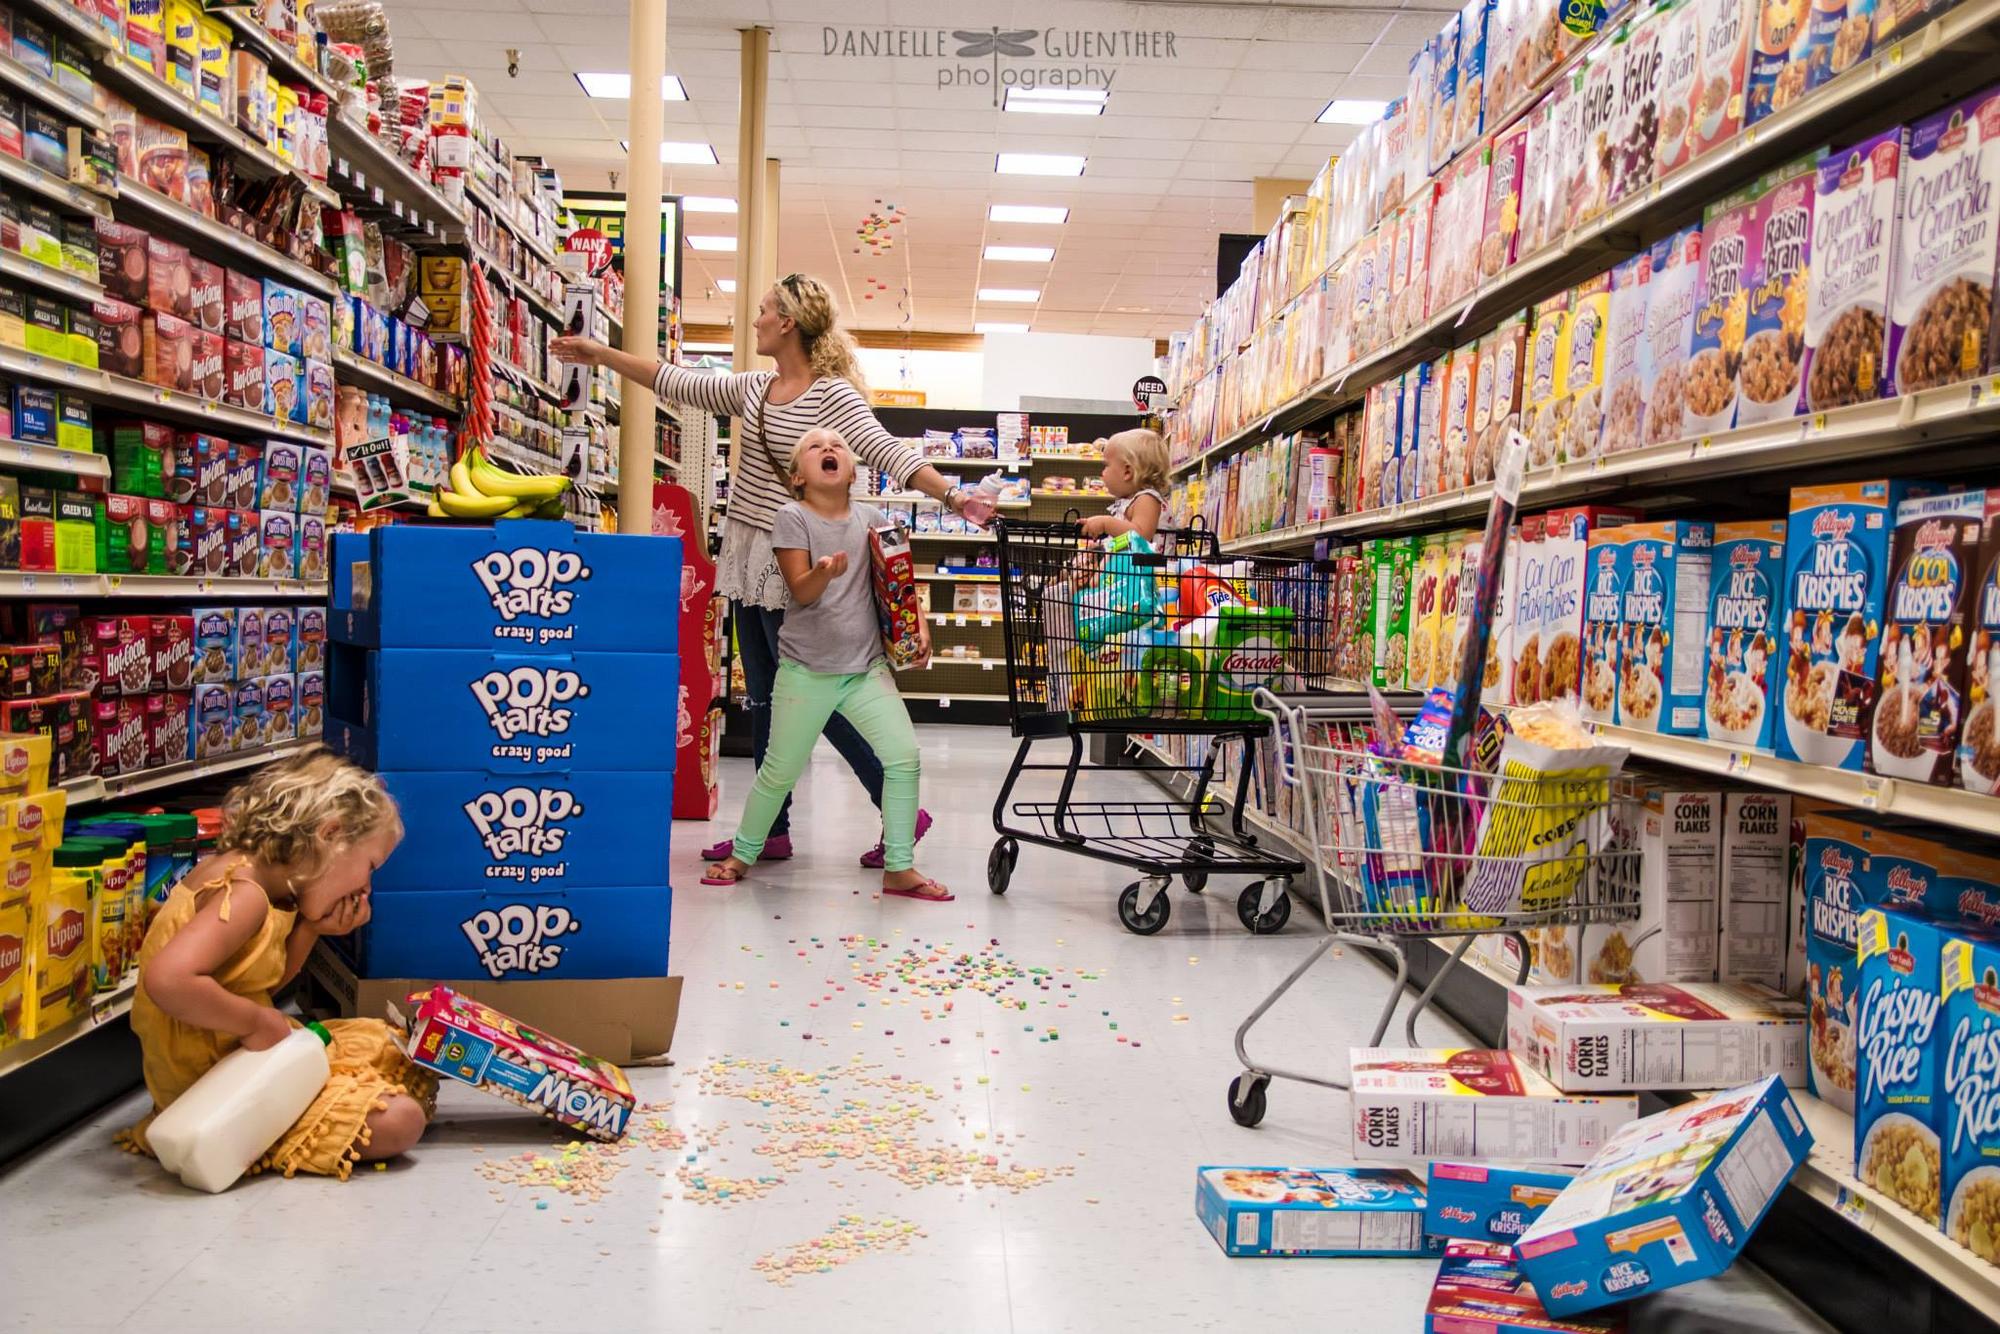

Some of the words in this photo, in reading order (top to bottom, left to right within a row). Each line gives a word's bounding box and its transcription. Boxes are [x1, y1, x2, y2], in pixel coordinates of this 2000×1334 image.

[1569, 1, 1595, 19] ON
[1706, 19, 1738, 58] Bran
[1908, 149, 1983, 220] Crunchy
[1816, 189, 1877, 251] Crunchy
[1920, 180, 1992, 249] Granola
[571, 237, 607, 252] WANT
[1765, 208, 1808, 257] Raisin
[1825, 216, 1883, 278] Granola
[1708, 235, 1746, 277] Raisin
[1766, 242, 1800, 281] Bran
[1911, 241, 1949, 281] Raisin
[1951, 220, 1987, 254] Bran
[1850, 254, 1880, 284] Bran
[1709, 268, 1739, 303] Bran
[50, 312, 61, 326] TEA
[1136, 392, 1149, 401] IT?
[1137, 382, 1164, 393] NEED
[62, 503, 80, 517] GREEN
[81, 504, 92, 518] TEA
[1922, 499, 1952, 514] VITAMIN
[1549, 555, 1575, 590] Corn
[1814, 541, 1849, 575] RICE
[1634, 570, 1651, 596] RICE
[1730, 571, 1756, 599] RICE
[1796, 573, 1866, 612] KRISPIES
[492, 587, 574, 621] tarts
[1208, 591, 1231, 607] Tide
[1543, 589, 1577, 626] Flakes
[1625, 595, 1663, 624] KRISPIES
[1716, 598, 1768, 628] KRISPIES
[1895, 582, 1954, 620] KRISPIES
[64, 631, 76, 644] TEA
[494, 625, 534, 643] crazy
[539, 625, 573, 644] good
[47, 654, 60, 667] TEA
[107, 653, 124, 677] Hot
[123, 638, 146, 667] Cocoa
[156, 651, 170, 673] Hot
[169, 637, 190, 664] Cocoa
[1223, 652, 1283, 674] Cascade
[490, 706, 572, 740] tarts
[1832, 705, 1859, 715] MOVIE
[77, 719, 88, 732] TEA
[107, 733, 123, 757] Hot
[122, 715, 142, 746] Cocoa
[154, 726, 168, 748] Hot
[492, 745, 532, 761] crazy
[536, 744, 571, 762] good
[18, 810, 42, 827] Lipton
[1674, 804, 1710, 819] CORN
[1739, 805, 1778, 820] CORN
[1674, 820, 1711, 834] FLAKES
[1739, 821, 1778, 835] FLAKES
[484, 825, 565, 860] tarts
[8, 867, 31, 884] Lipton
[485, 865, 525, 881] crazy
[530, 863, 564, 882] good
[1821, 845, 1854, 880] Kellogg's
[1825, 875, 1851, 911] RICE
[1887, 865, 1928, 901] Kellogg's
[49, 921, 83, 950] Lipton
[481, 943, 562, 978] tarts
[1859, 978, 1941, 1050] Crispy
[1578, 1036, 1594, 1078] CORN
[1595, 1035, 1609, 1077] FLAKES
[1864, 1030, 1921, 1106] Rice
[1368, 1106, 1384, 1148] CORN
[1386, 1106, 1400, 1148] FLAKES
[1440, 1206, 1477, 1225] Kellogg's
[1500, 1210, 1523, 1225] RICE
[1602, 1271, 1651, 1294] KRISPIES
[1610, 1262, 1632, 1280] RICE
[1551, 1280, 1588, 1299] Kellogg's
